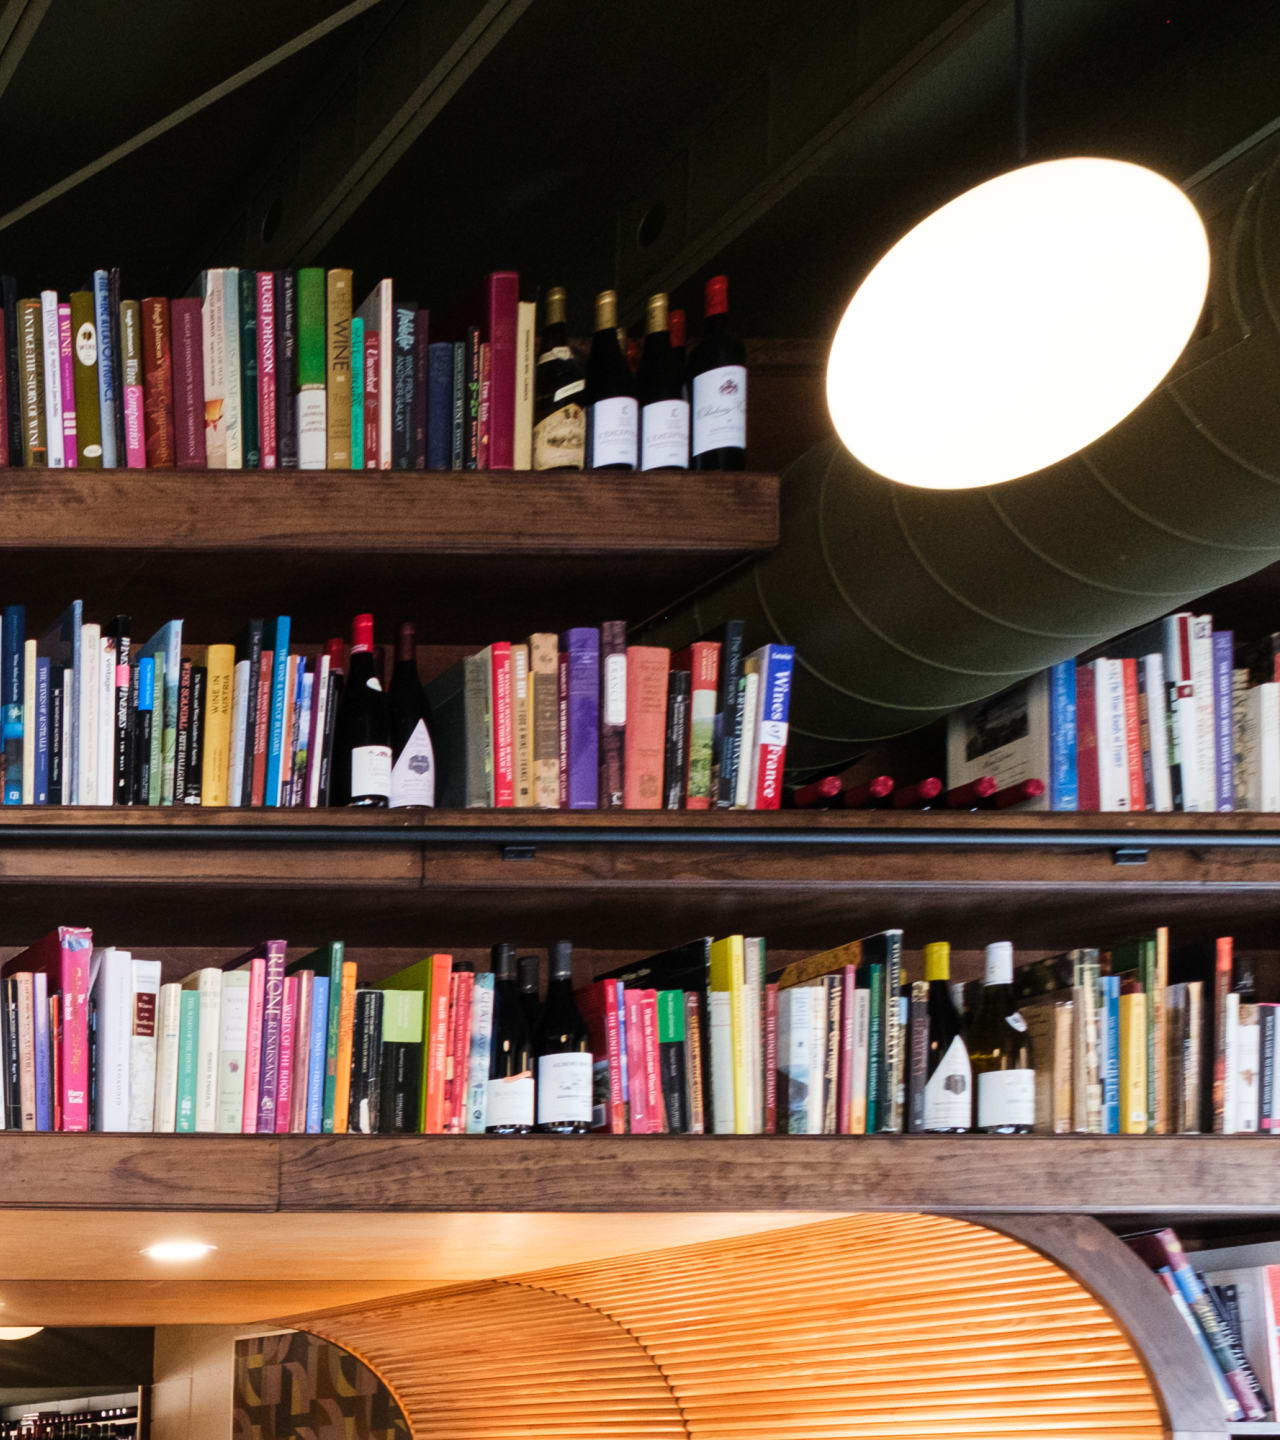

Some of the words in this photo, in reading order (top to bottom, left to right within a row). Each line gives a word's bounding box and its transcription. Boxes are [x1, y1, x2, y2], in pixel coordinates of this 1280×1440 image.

[262, 275, 272, 312] HUGH
[61, 320, 71, 356] WINE
[262, 315, 273, 372] JOHNSON
[333, 319, 349, 371] WINE
[181, 662, 191, 685] WINE
[179, 688, 190, 729] SCANDAL
[770, 671, 791, 720] Wines
[178, 731, 187, 749] FRITZ
[769, 725, 783, 741] of
[176, 752, 186, 799] HALLGARTEN
[763, 745, 783, 798] France
[608, 1012, 616, 1028] THE
[609, 1030, 617, 1056] WINES
[610, 1058, 618, 1067] OF
[610, 1069, 620, 1105] GEORGIA
